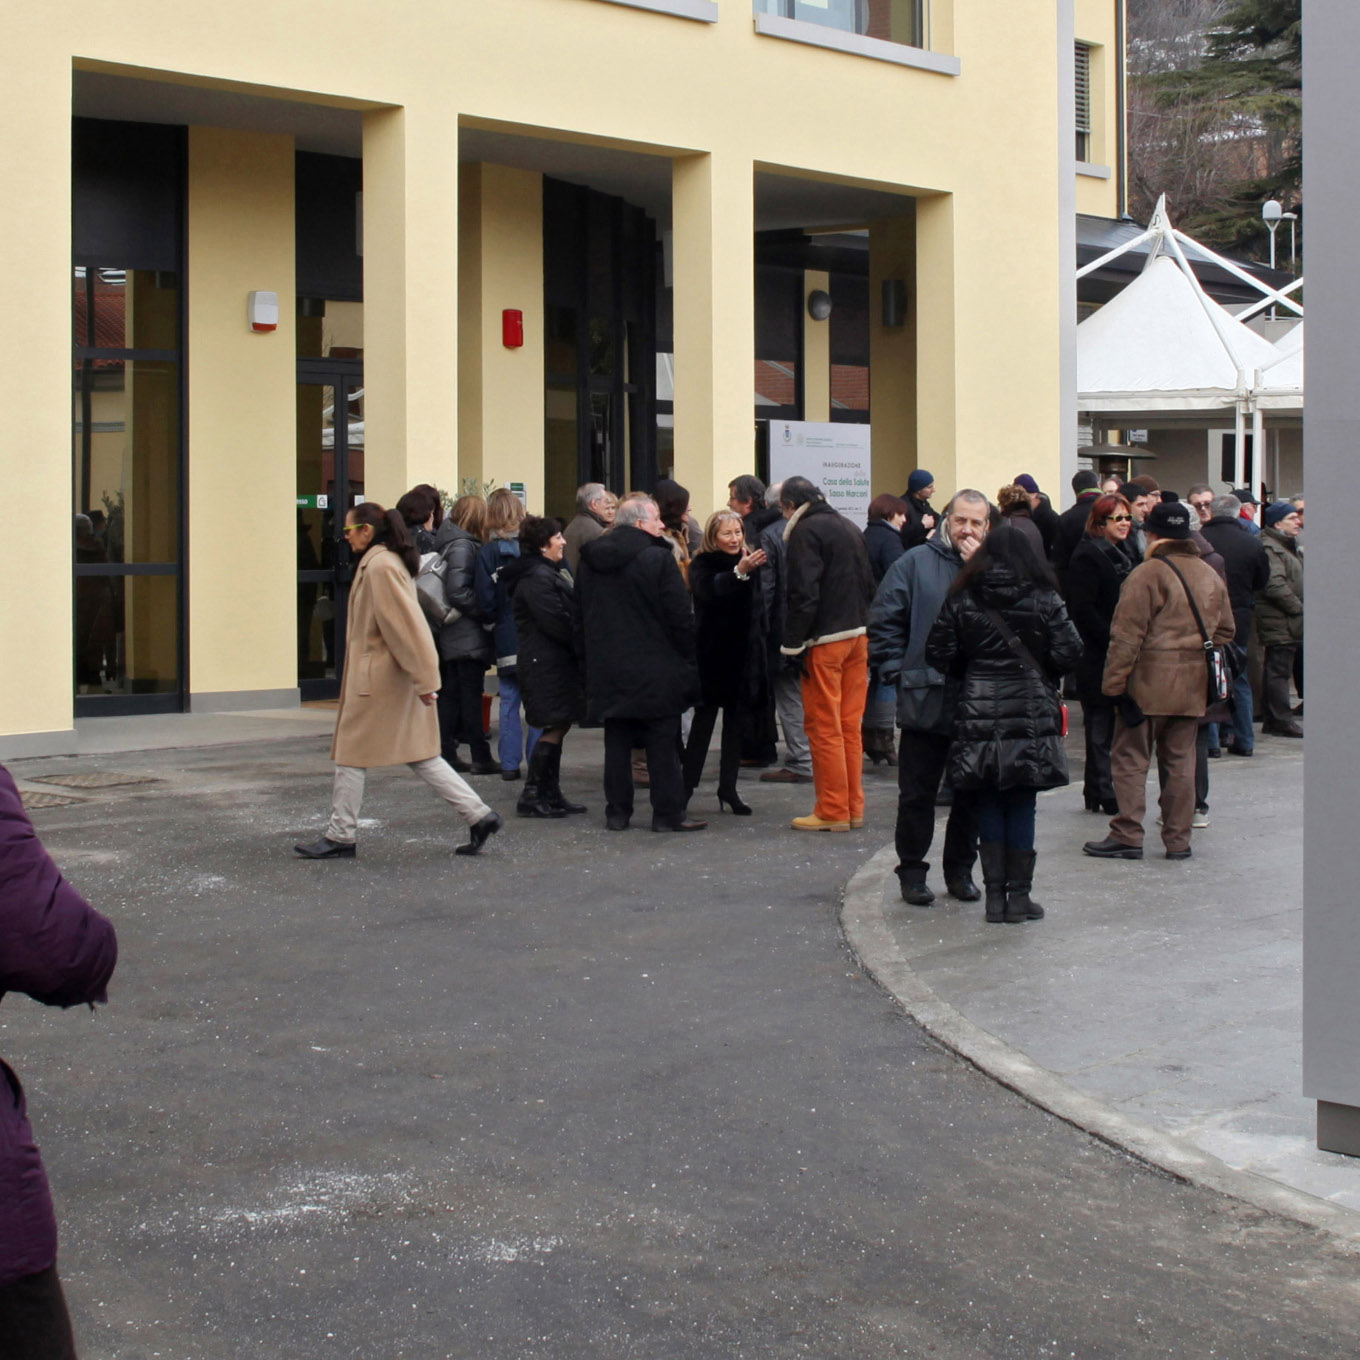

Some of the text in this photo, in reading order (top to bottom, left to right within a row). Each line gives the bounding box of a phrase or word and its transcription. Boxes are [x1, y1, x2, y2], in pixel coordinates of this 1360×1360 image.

[822, 477, 869, 487] Casa della Salute
[845, 490, 868, 498] Marconi
